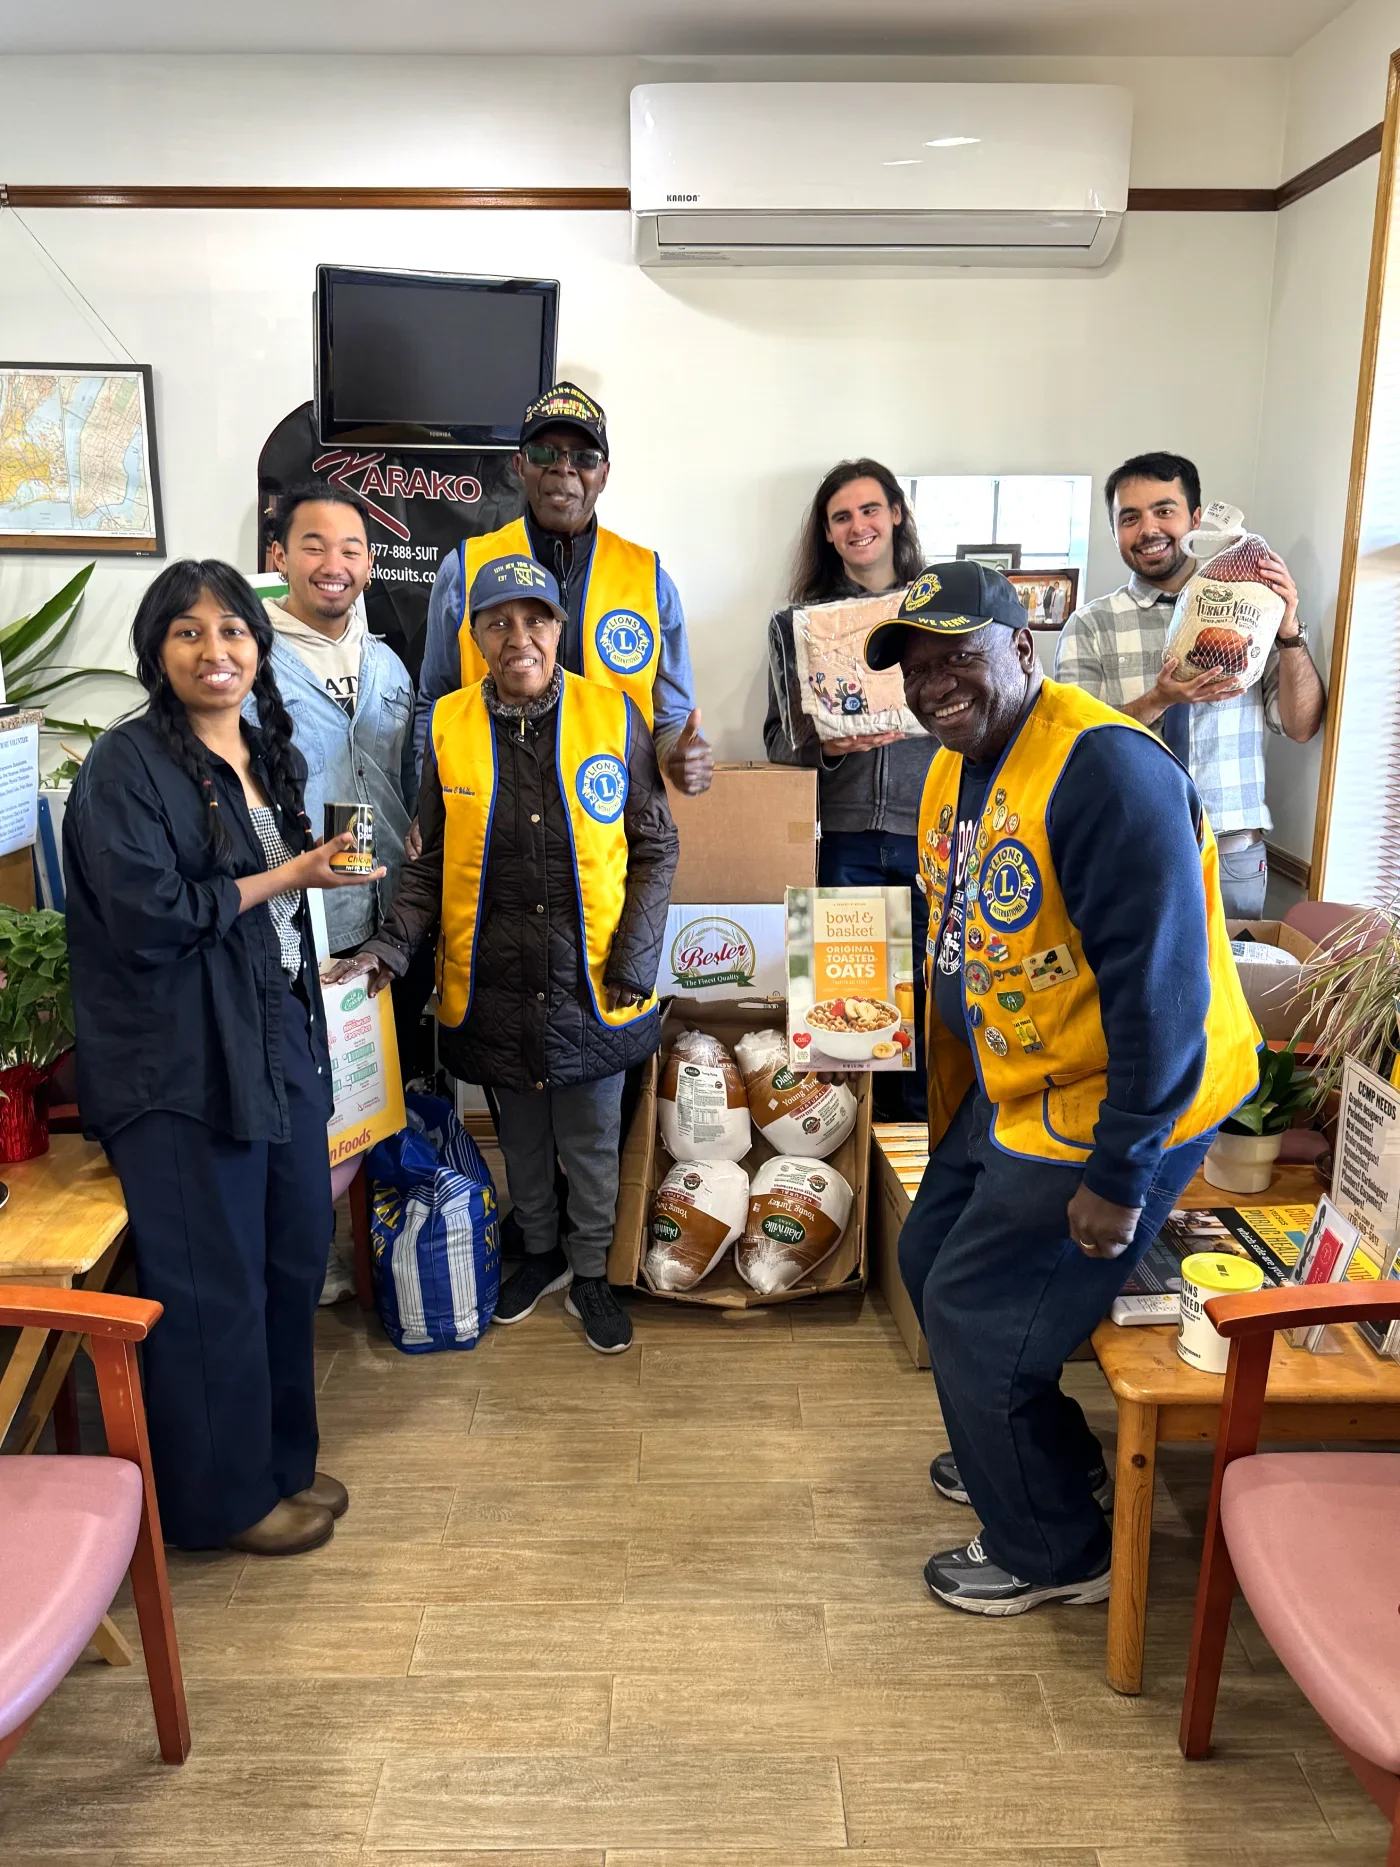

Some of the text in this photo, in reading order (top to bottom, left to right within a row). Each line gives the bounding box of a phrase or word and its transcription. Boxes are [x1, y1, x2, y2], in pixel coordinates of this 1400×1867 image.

[533, 387, 564, 411] VIETNAM
[546, 408, 587, 421] VETERAN
[312, 450, 482, 541] KARAKO
[1196, 595, 1261, 621] TURKEY VALLEY
[609, 616, 639, 629] LIONS
[918, 615, 971, 628] WE SERVE
[617, 631, 633, 650] L
[587, 762, 617, 779] LIONS
[599, 776, 615, 798] L
[993, 848, 1022, 868] LIONS
[999, 870, 1014, 897] L
[826, 910, 874, 924] bowl &
[991, 903, 1025, 918] INTERNATIONAL
[826, 924, 875, 938] basket
[826, 945, 875, 953] ORIGINAL
[826, 954, 875, 963] TOASTED
[825, 963, 876, 979] OATS
[685, 974, 740, 987] The Finest Quality
[781, 1089, 806, 1107] Young
[800, 1090, 826, 1111] NATURAL
[1357, 1080, 1397, 1121] CCMP NEEDS
[1349, 1092, 1384, 1127] Graphic designers!
[338, 1128, 371, 1156] Foods
[780, 1189, 812, 1203] NATURAL
[669, 1203, 688, 1219] Young
[767, 1197, 815, 1222] Young Turkey
[1269, 1208, 1288, 1226] versus
[764, 1219, 804, 1242] plainville
[1240, 1209, 1280, 1235] PUBLIC
[1236, 1227, 1257, 1245] which
[1251, 1243, 1268, 1256] side
[1261, 1254, 1275, 1266] are
[1268, 1264, 1285, 1278] you
